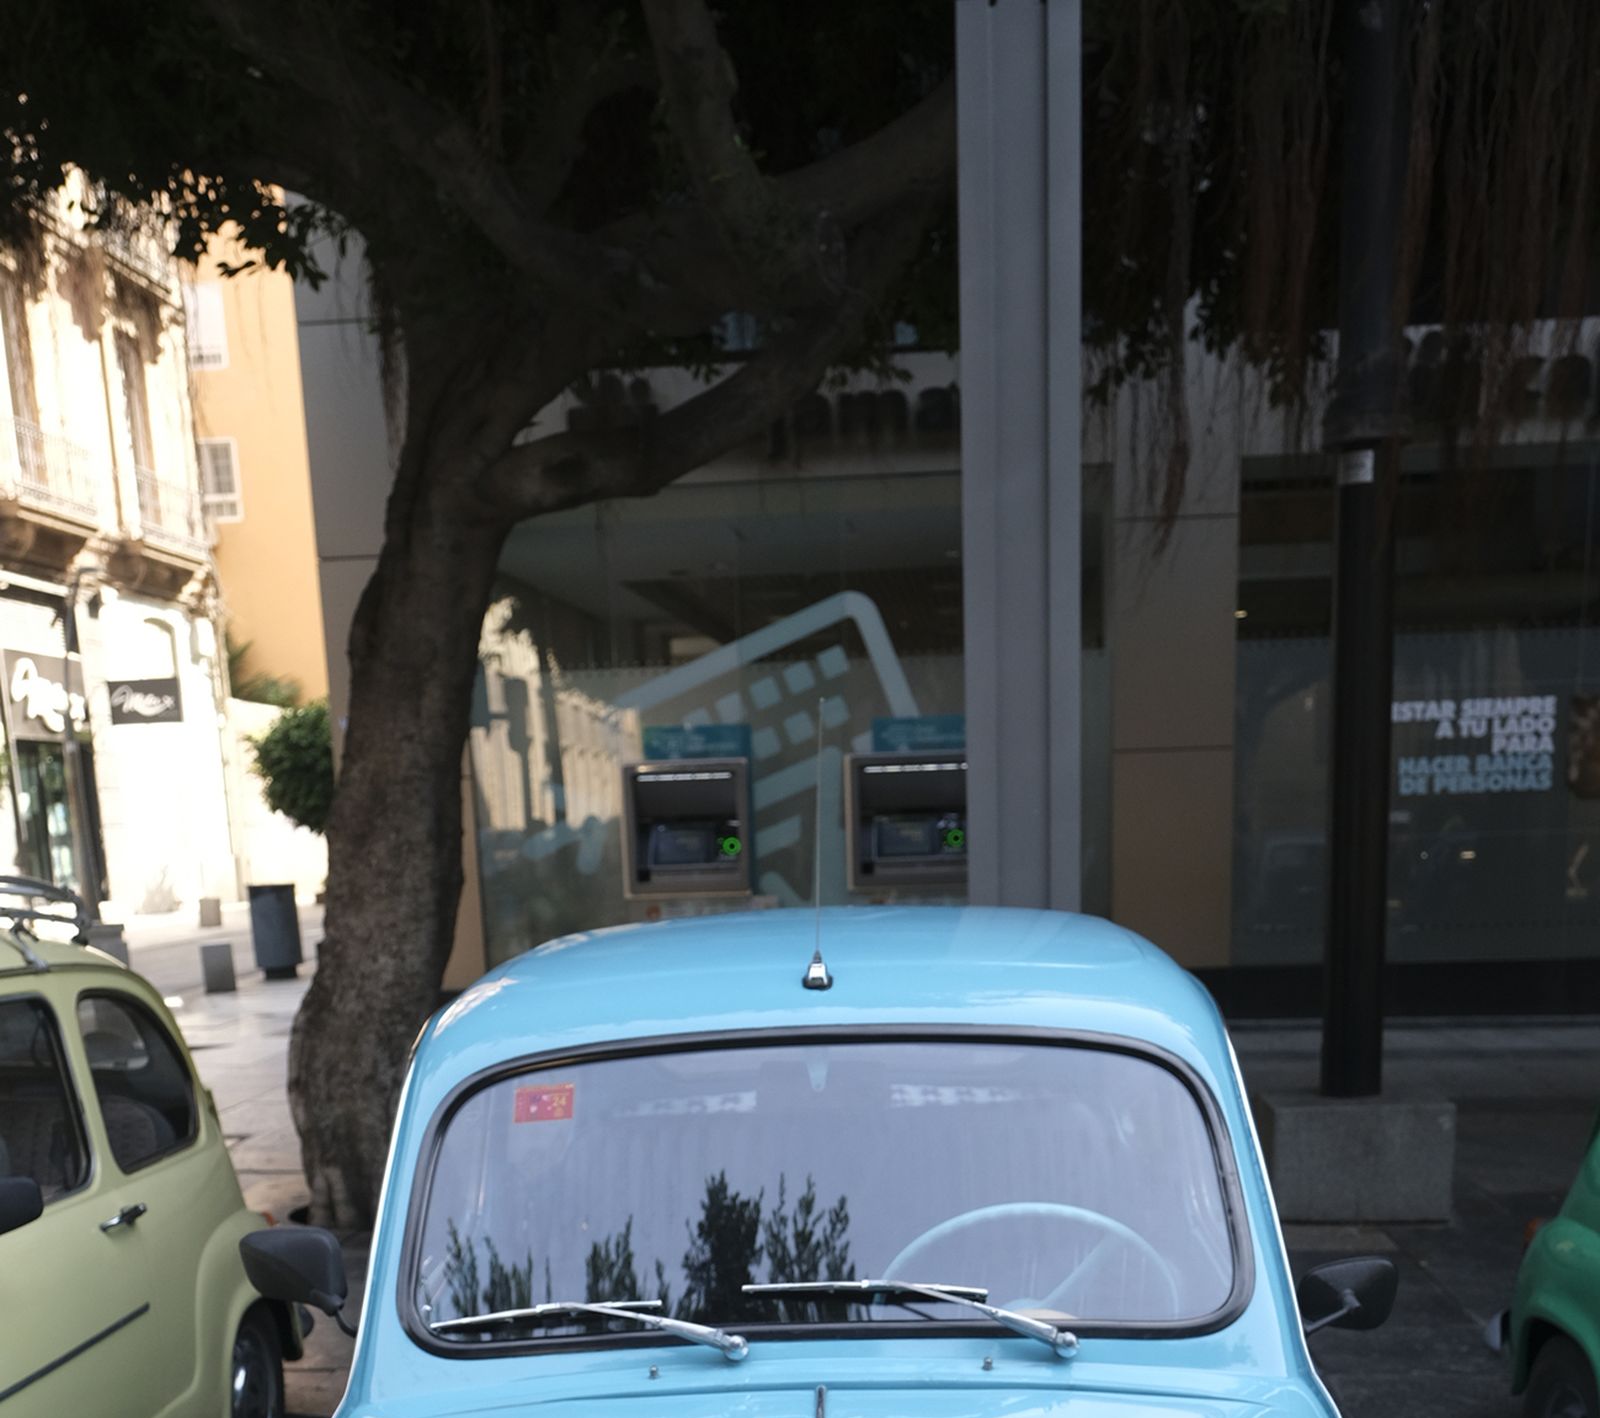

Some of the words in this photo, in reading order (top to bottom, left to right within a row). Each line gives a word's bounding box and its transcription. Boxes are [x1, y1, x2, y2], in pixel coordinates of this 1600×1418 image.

[1392, 699, 1456, 722] ESTAR
[1461, 696, 1557, 718] SIEMPRE
[1435, 719, 1454, 738] A
[1458, 717, 1488, 737] TU
[1492, 715, 1556, 735] LADO
[1491, 733, 1554, 754] PARA
[1398, 755, 1470, 775] HACER
[1475, 752, 1552, 773] BANCA
[1399, 775, 1428, 796] DE
[1433, 771, 1552, 794] PERSONAS
